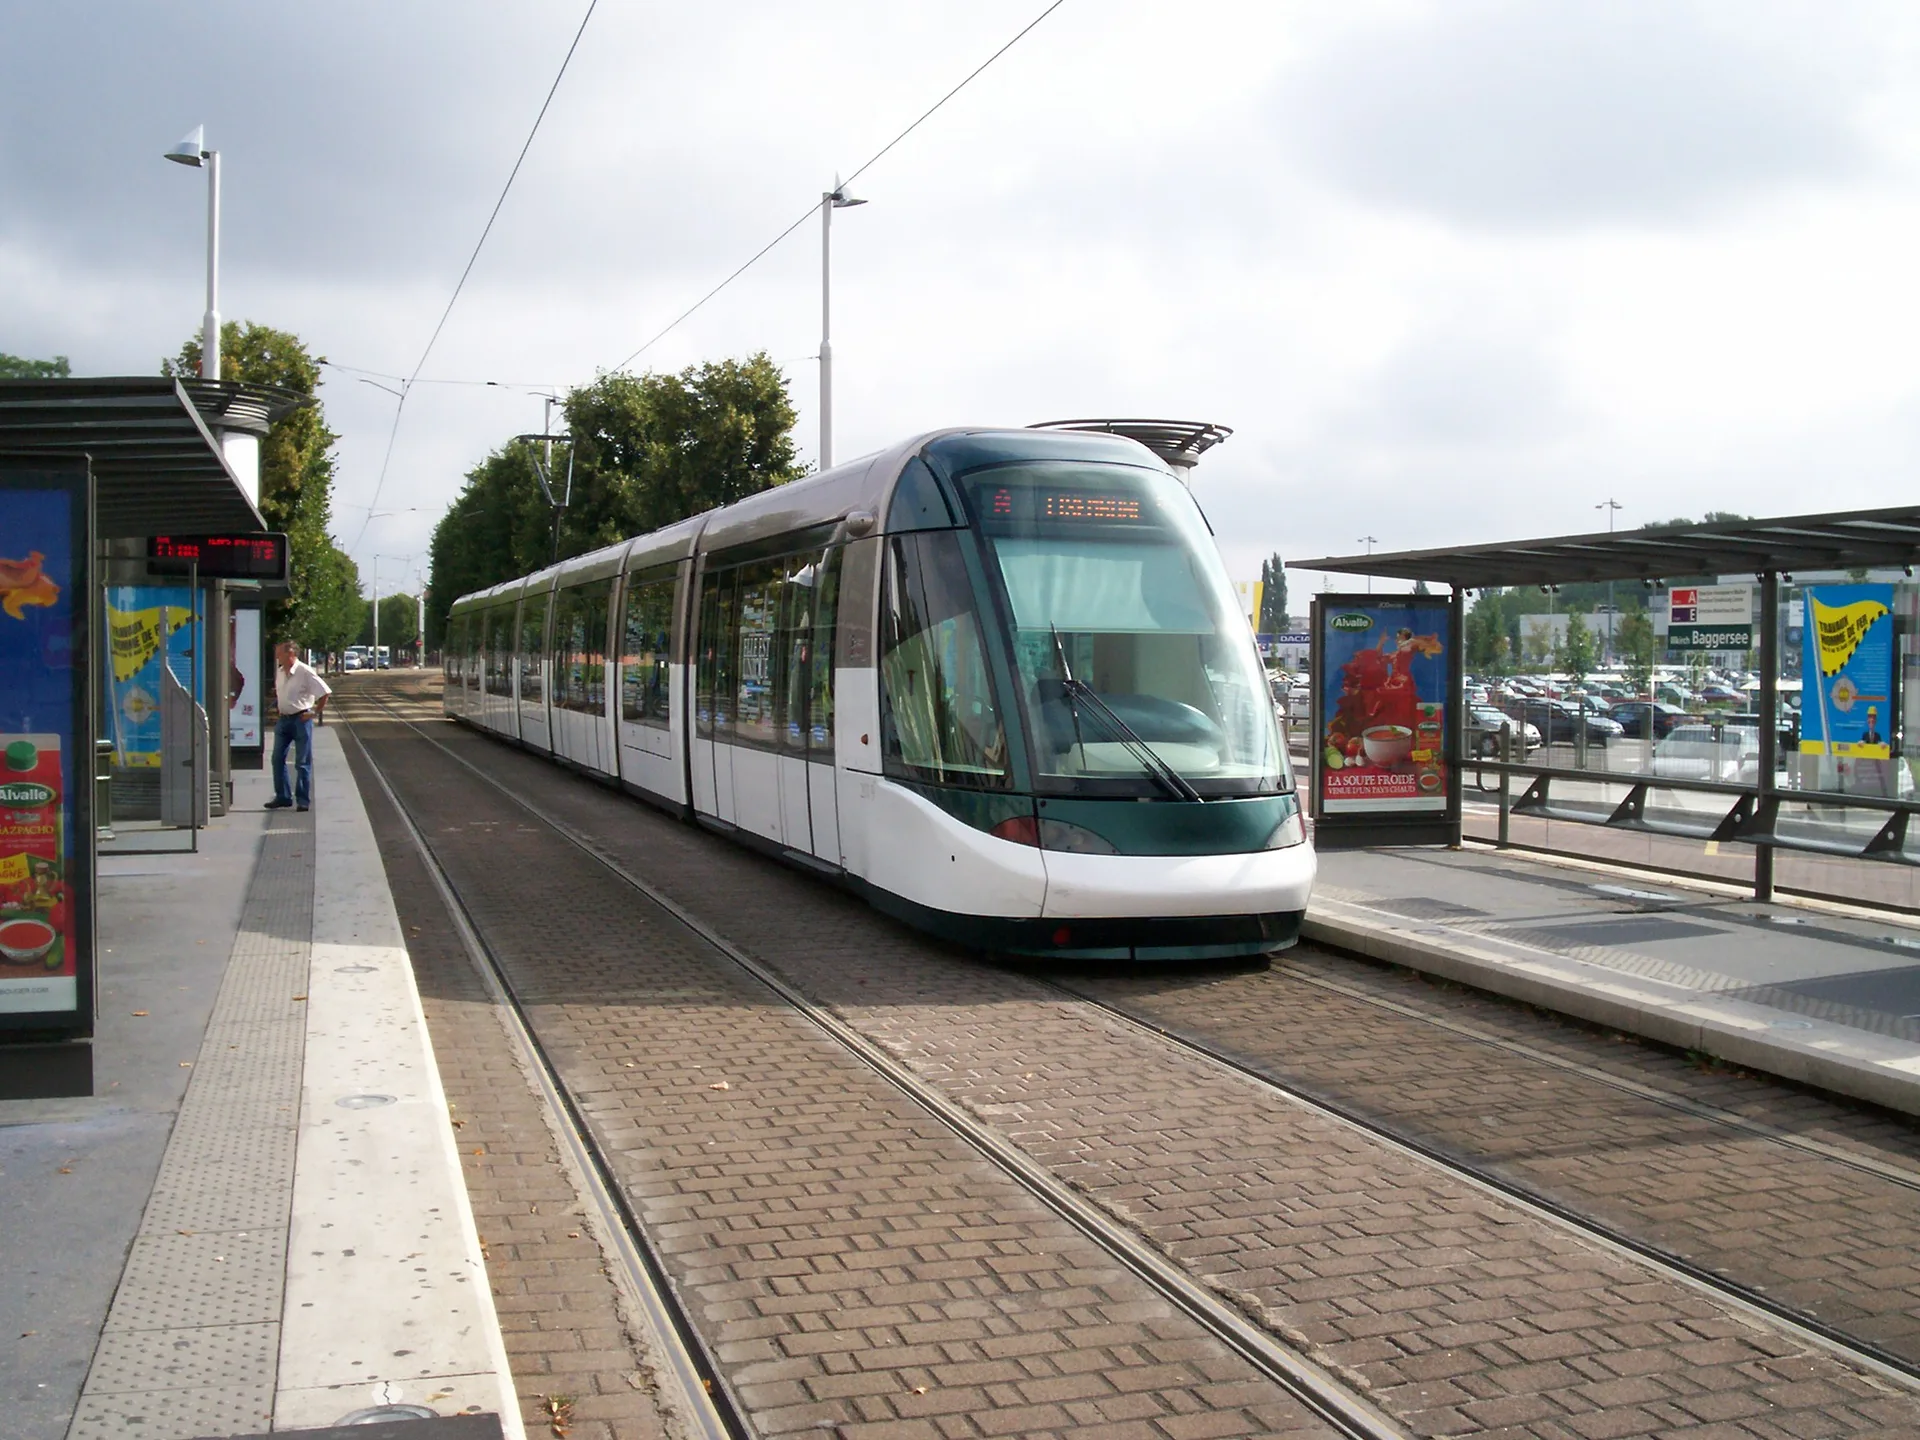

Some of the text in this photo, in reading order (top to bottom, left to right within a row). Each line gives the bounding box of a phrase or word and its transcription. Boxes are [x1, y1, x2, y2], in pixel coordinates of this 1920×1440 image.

[1688, 591, 1697, 604] A
[1690, 608, 1696, 621] E
[1335, 618, 1369, 627] Alvalle
[1847, 624, 1856, 638] DE
[1692, 630, 1749, 648] Baggersee
[1328, 774, 1415, 786] LA SOUPE FROIDE
[0, 789, 48, 800] Alvalle
[1372, 786, 1389, 794] PAYS
[0, 825, 54, 835] AZPACHO
